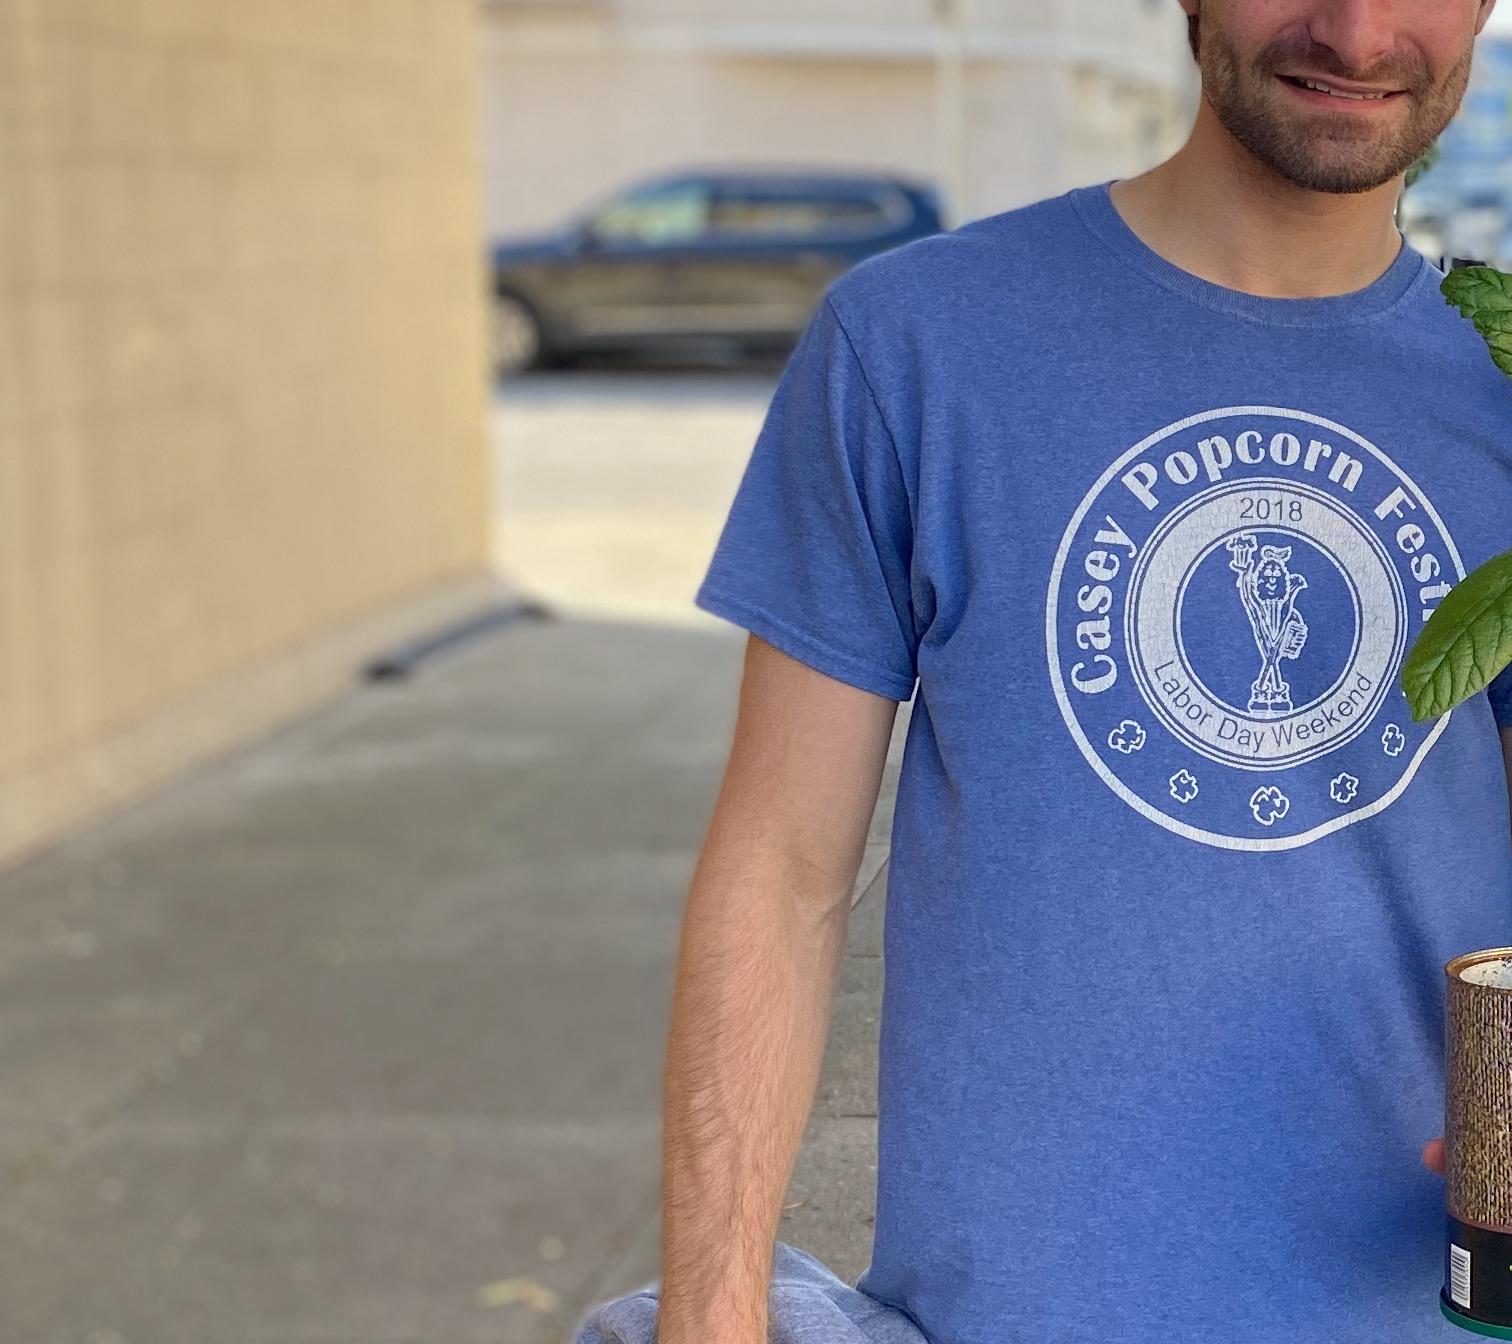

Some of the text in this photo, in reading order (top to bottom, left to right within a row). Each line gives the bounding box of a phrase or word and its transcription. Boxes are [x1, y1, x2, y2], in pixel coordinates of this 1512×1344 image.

[1239, 497, 1303, 522] 2018
[1071, 514, 1138, 693] Casey
[1121, 430, 1364, 511] Popcorn
[1154, 660, 1374, 753] Labor Day Weekend
